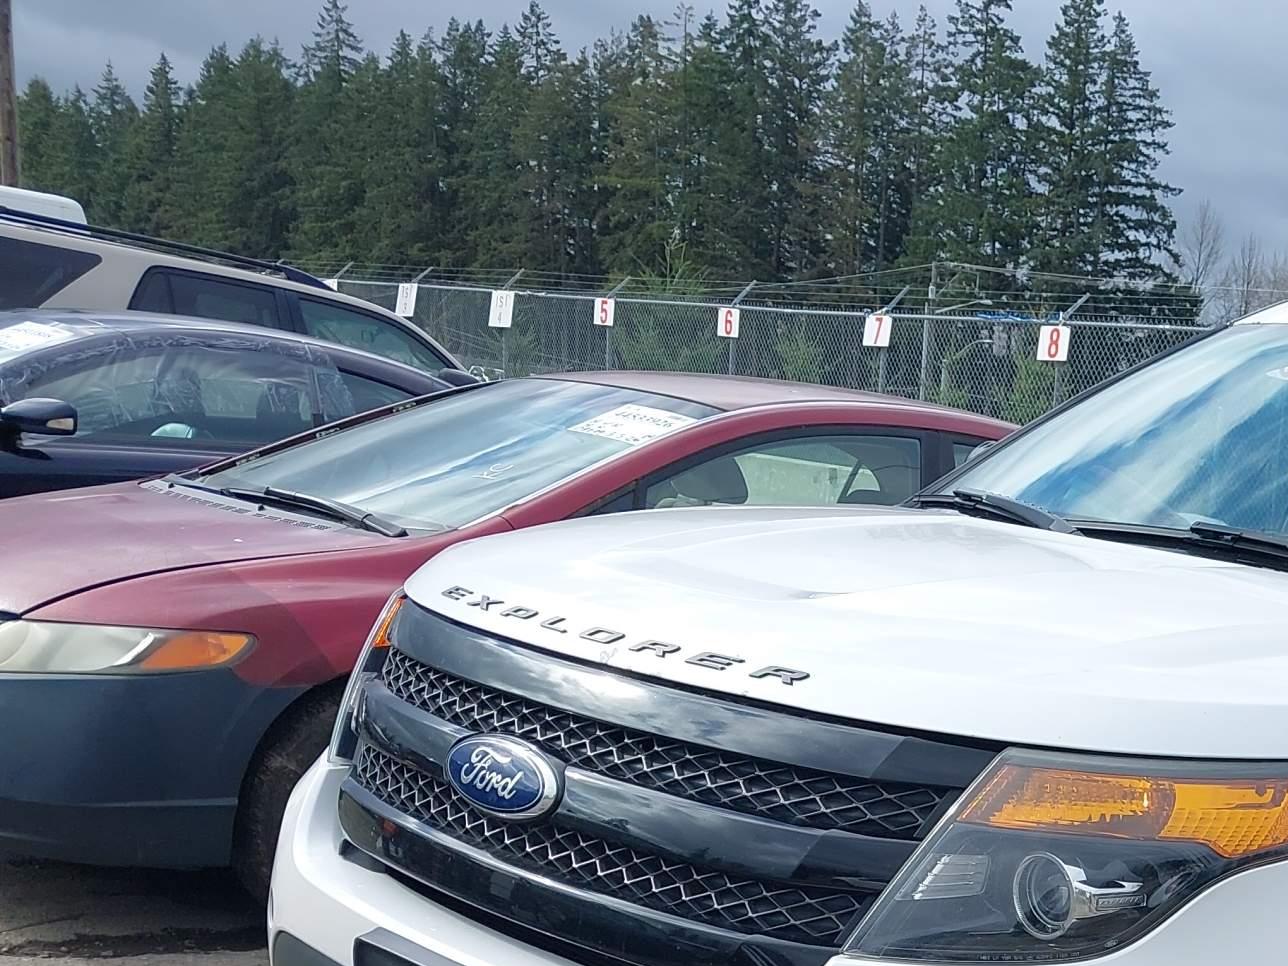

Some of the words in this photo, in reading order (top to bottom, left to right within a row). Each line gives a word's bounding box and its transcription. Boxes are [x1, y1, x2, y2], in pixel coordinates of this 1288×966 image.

[600, 300, 608, 324] 5
[724, 310, 733, 335] 6
[873, 317, 883, 344] 7
[1047, 328, 1060, 358] 8
[441, 585, 811, 686] EXPLORER
[460, 746, 524, 800] Ford
